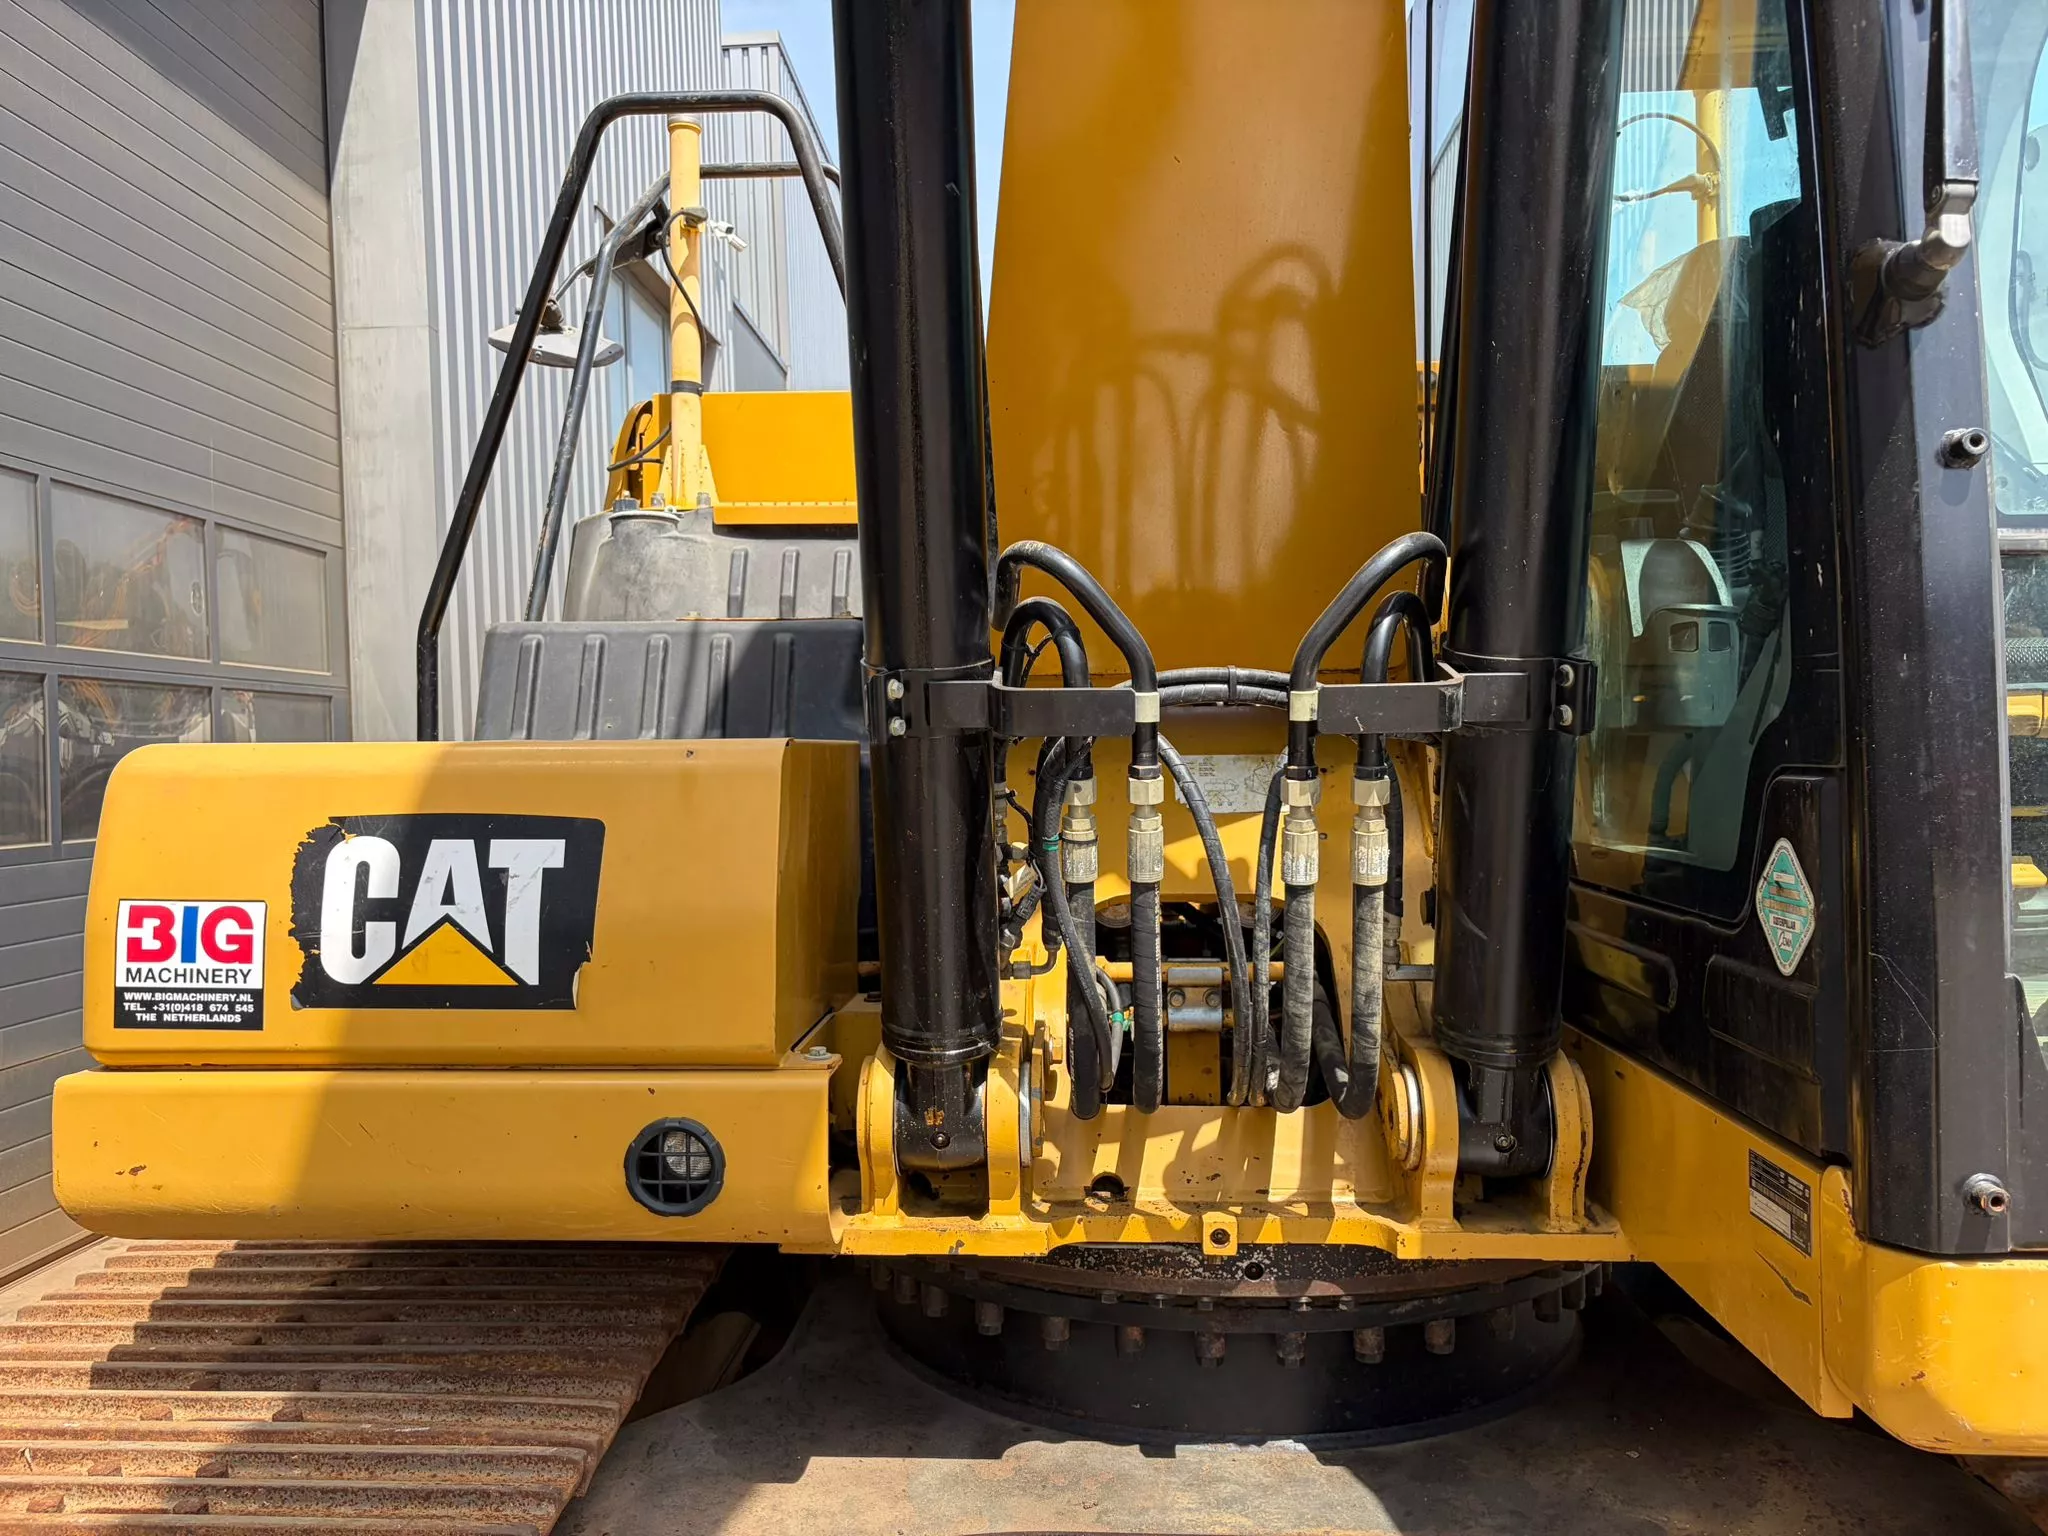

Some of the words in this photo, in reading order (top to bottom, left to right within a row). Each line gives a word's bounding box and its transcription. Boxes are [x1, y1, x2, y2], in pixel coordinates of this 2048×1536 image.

[320, 835, 566, 985] CAT
[127, 905, 254, 964] BIG
[125, 967, 252, 984] MACHINERY
[123, 992, 254, 1002] WWW.BIGMACHINERY.NL
[123, 1002, 146, 1011] TEL.
[152, 1003, 203, 1012] +31(0)418
[209, 1004, 229, 1012] 674
[235, 1004, 254, 1012] 545
[136, 1013, 157, 1021] THE
[163, 1013, 242, 1023] NETHERLANDS
